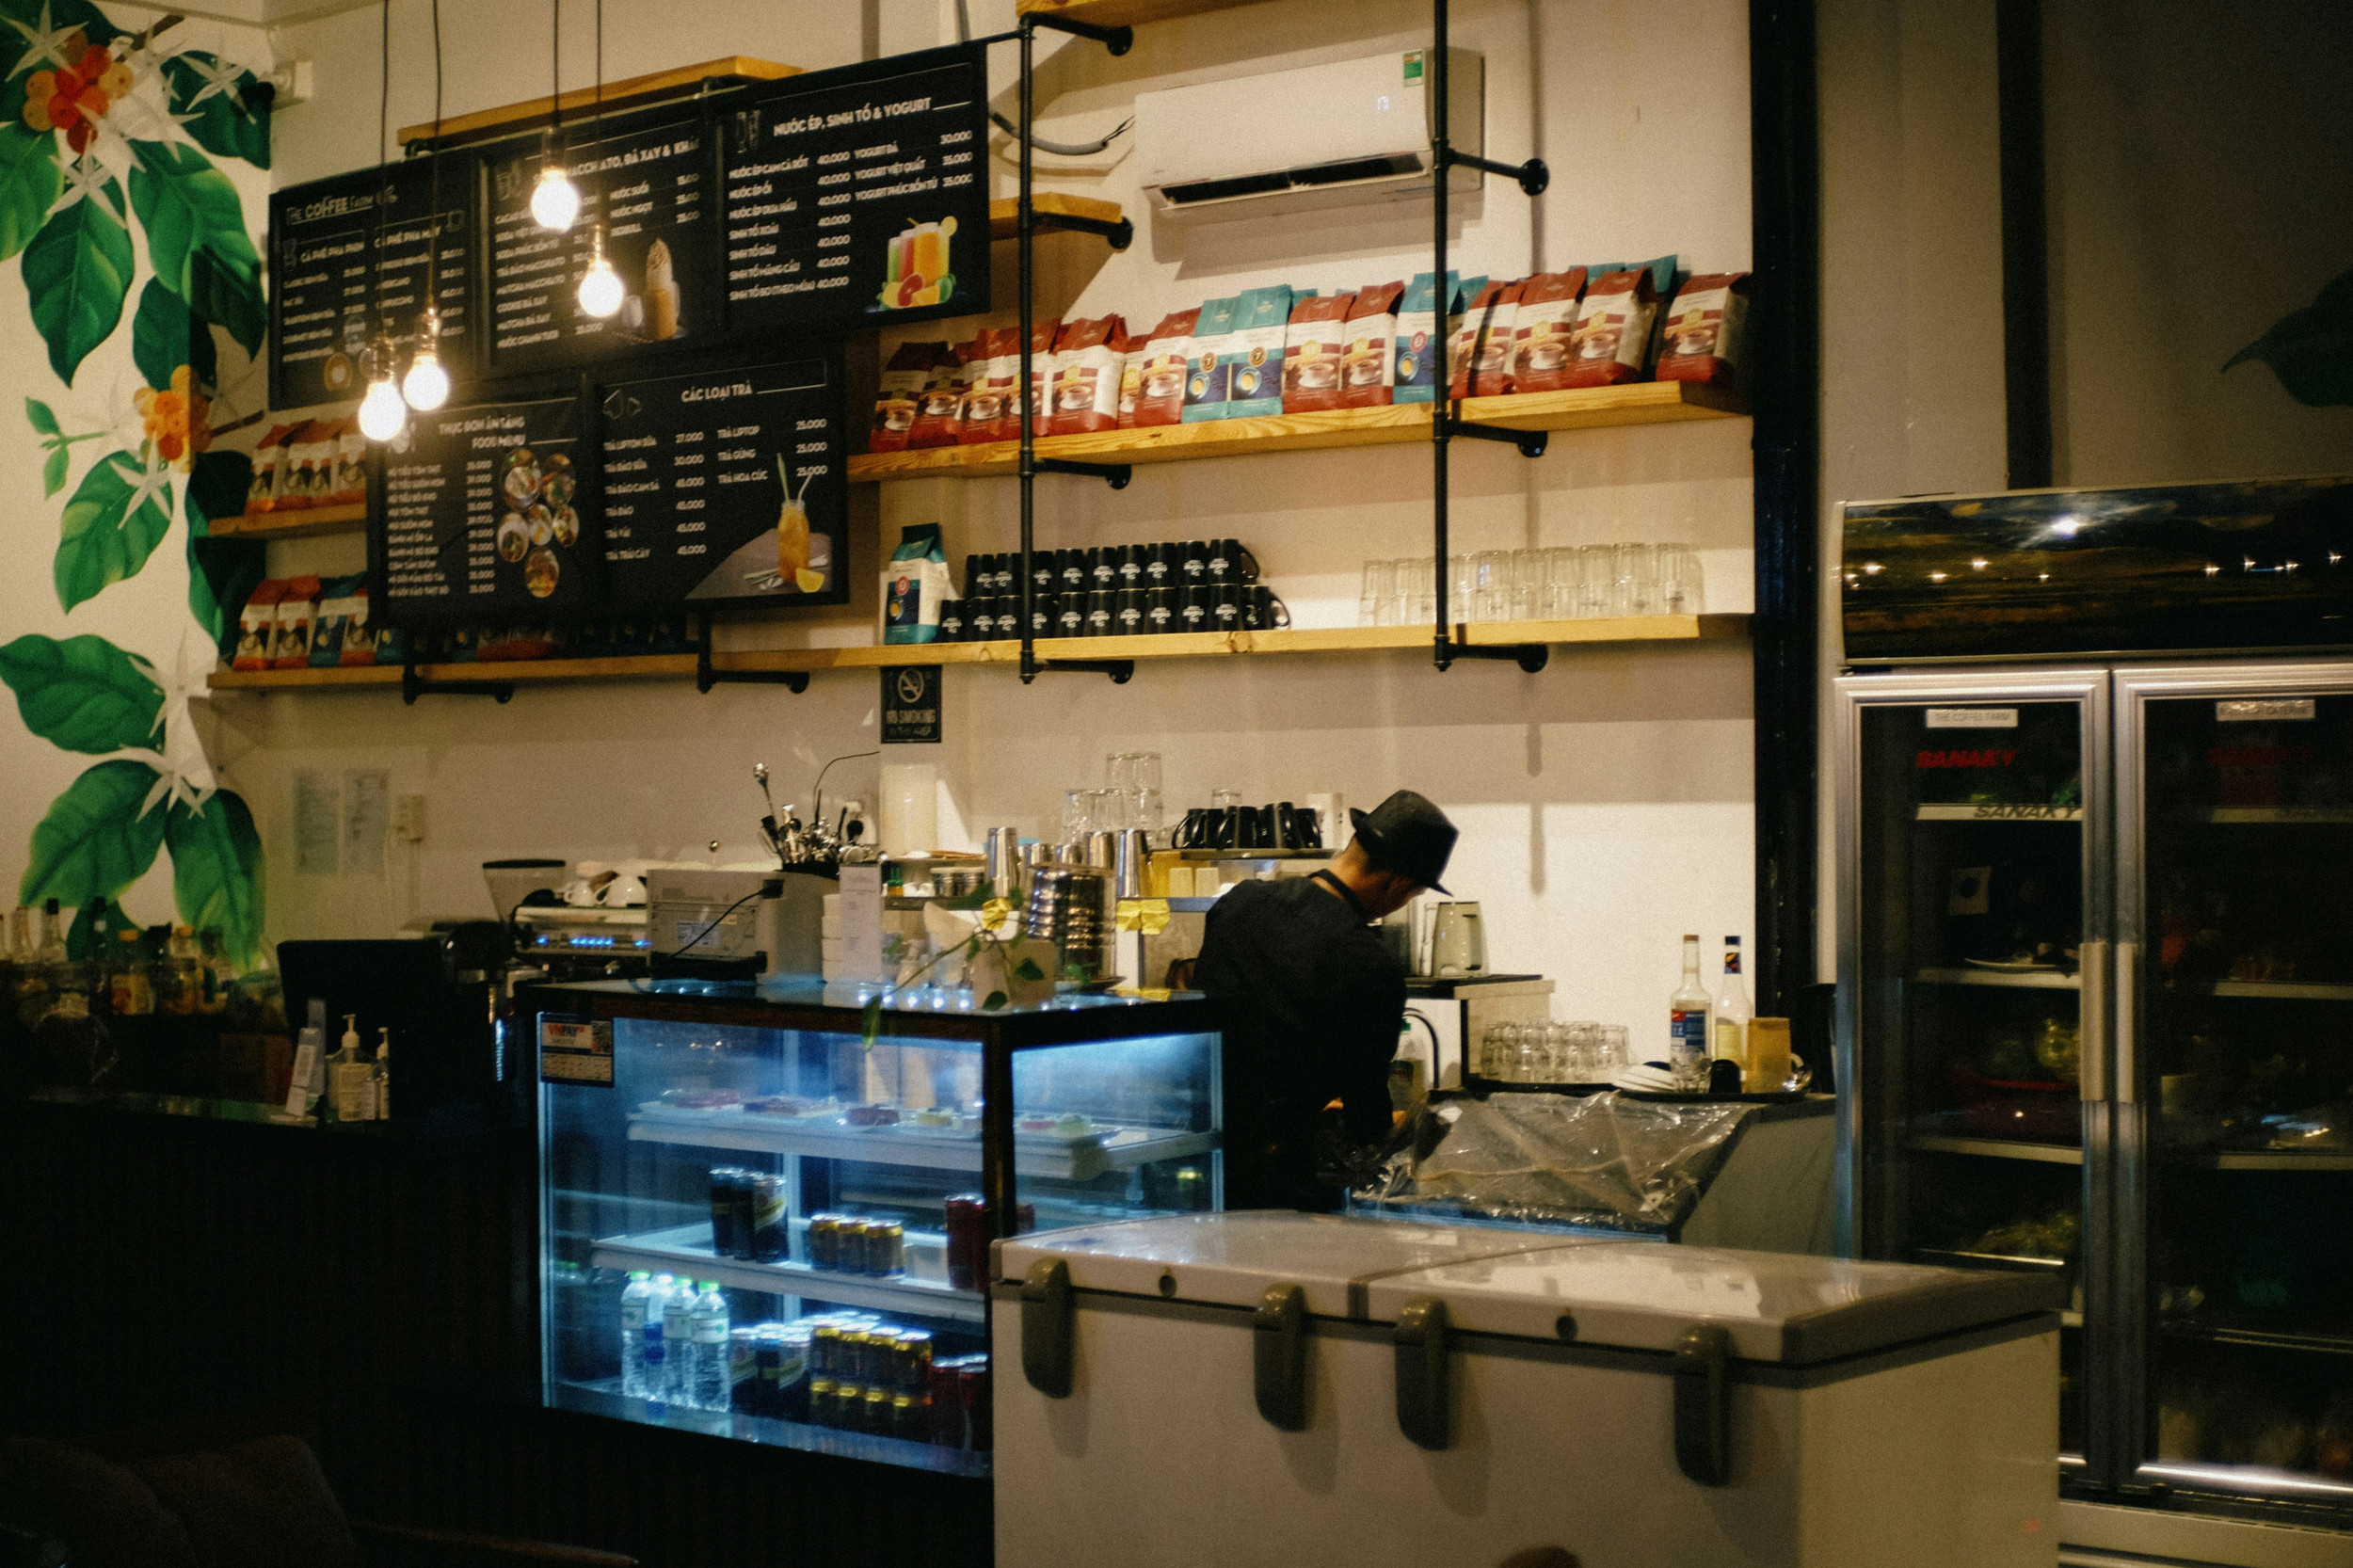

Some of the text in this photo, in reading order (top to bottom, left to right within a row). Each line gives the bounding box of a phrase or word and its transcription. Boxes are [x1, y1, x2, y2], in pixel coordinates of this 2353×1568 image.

[872, 107, 882, 120] &
[883, 97, 932, 117] YOGURT
[305, 196, 347, 218] COFFEE
[680, 387, 703, 402] CÁC
[795, 419, 826, 430] 25.000
[795, 442, 827, 454] 25.000
[1915, 749, 2018, 768] SANAKY
